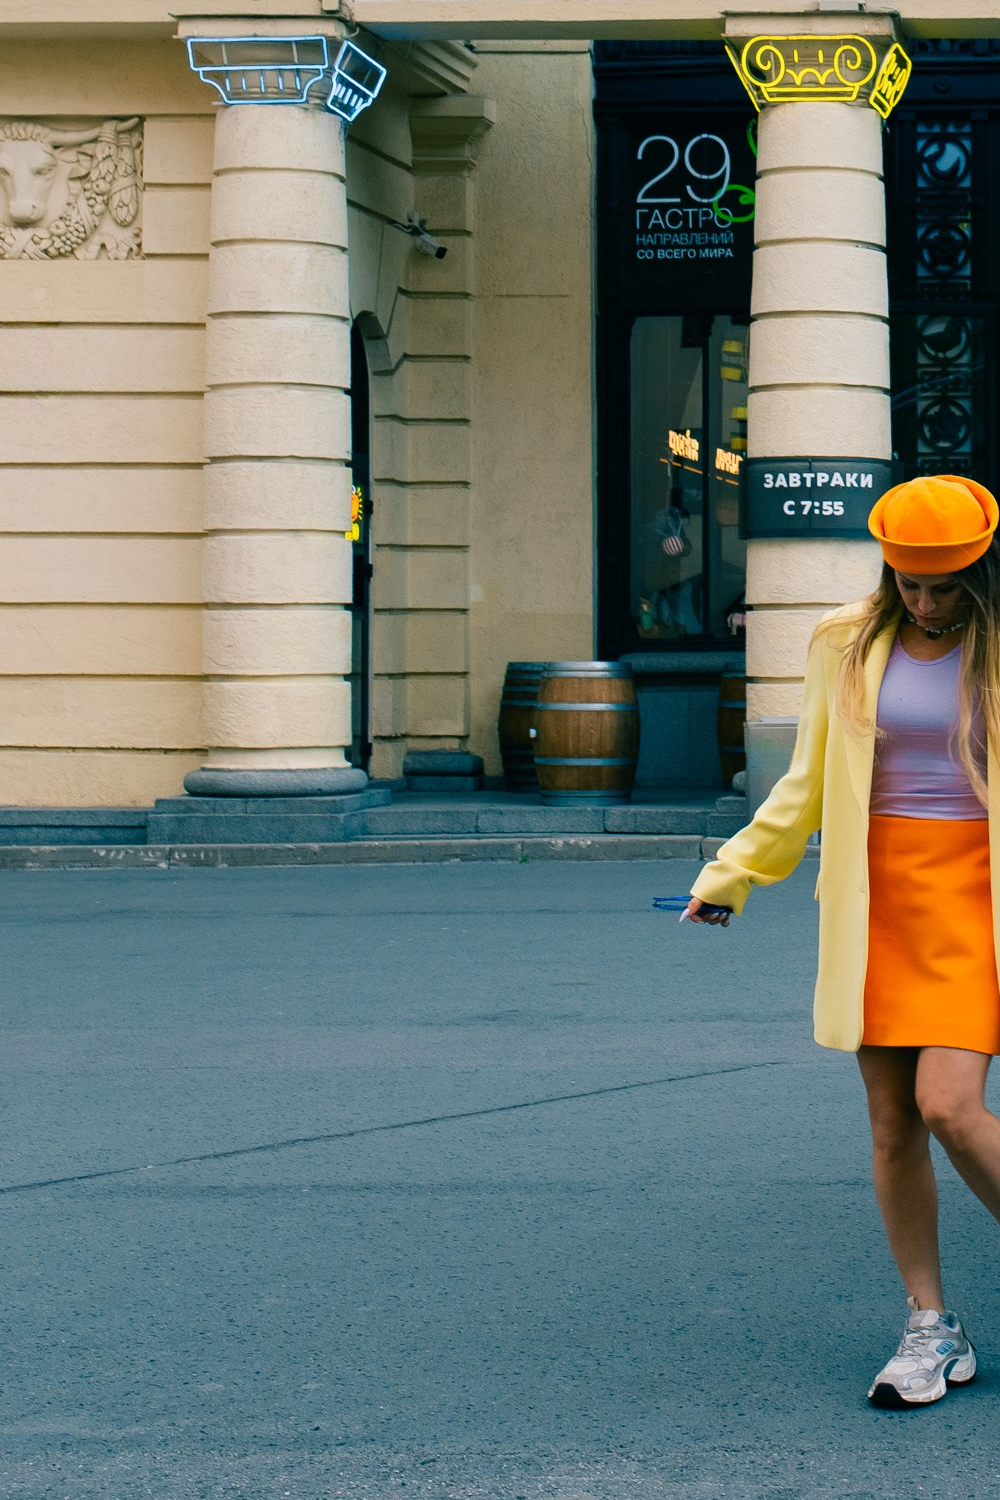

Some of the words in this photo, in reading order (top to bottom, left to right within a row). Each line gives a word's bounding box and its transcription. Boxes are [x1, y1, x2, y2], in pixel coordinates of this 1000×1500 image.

[636, 133, 731, 204] 29
[636, 207, 733, 229] ГАСТРО
[636, 230, 734, 245] НАПРАВЛЕНИЙ
[636, 249, 654, 260] СО
[657, 249, 697, 259] ВСЕГО
[699, 248, 734, 258] МИРА
[763, 472, 873, 488] ЗАВТРАКИ
[783, 500, 796, 515] С
[800, 500, 845, 516] 7:55
